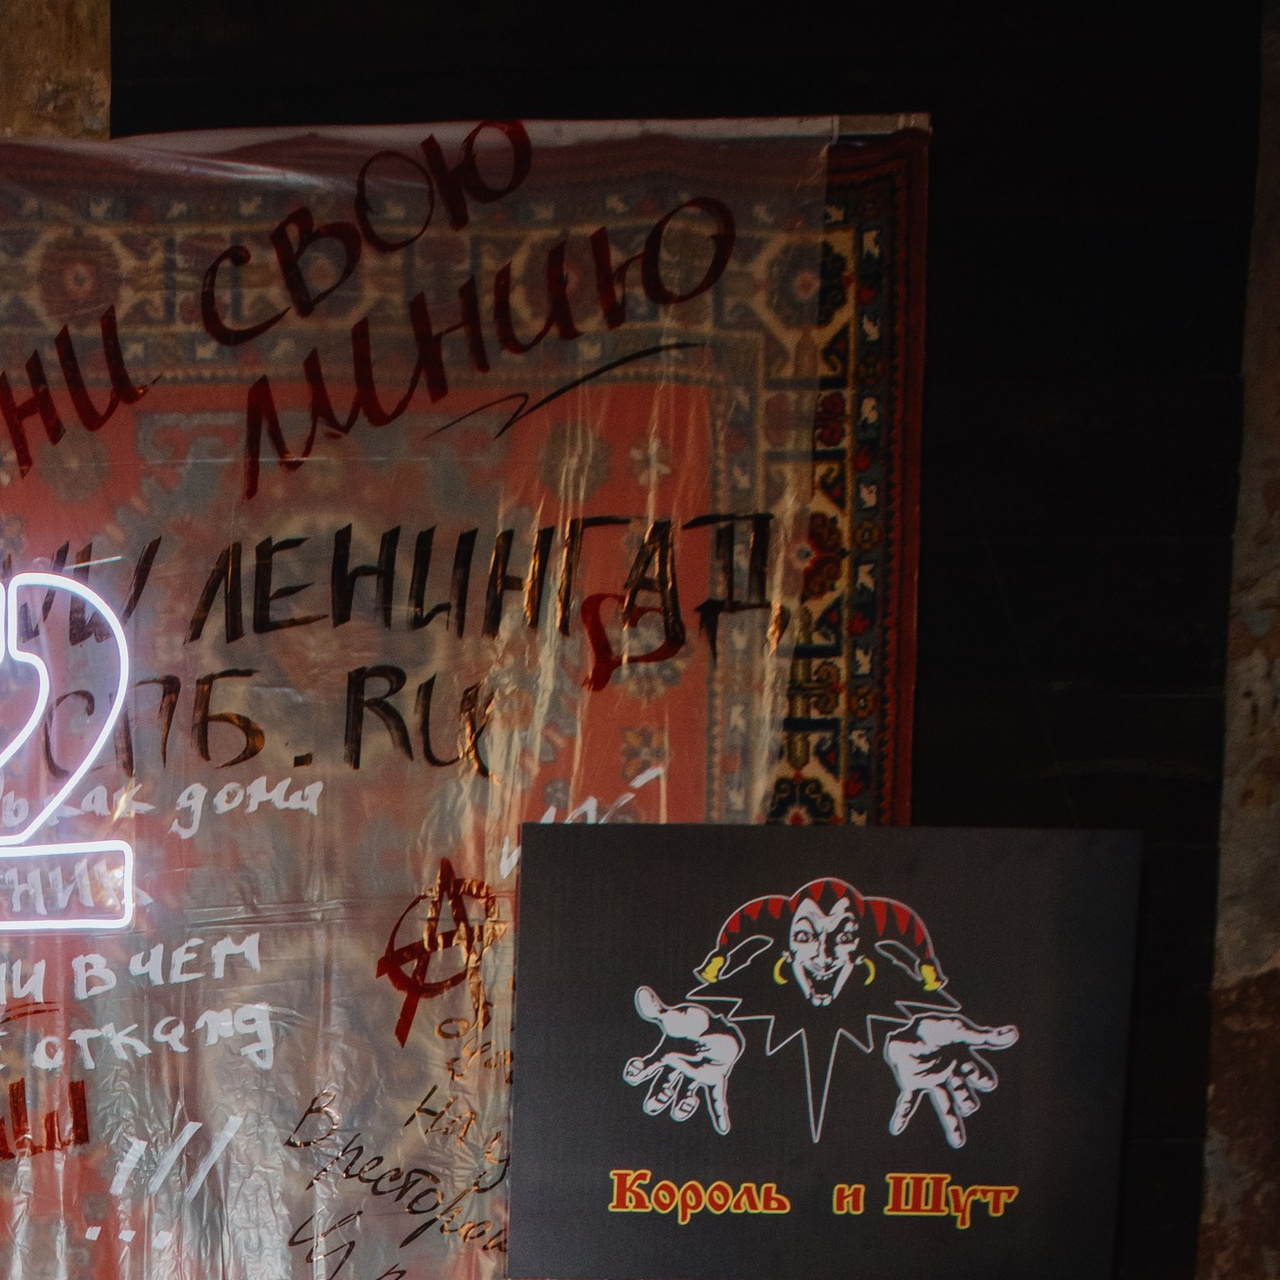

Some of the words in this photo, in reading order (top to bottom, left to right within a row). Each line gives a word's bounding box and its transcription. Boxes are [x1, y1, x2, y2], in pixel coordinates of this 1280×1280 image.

[200, 119, 532, 348] СВОЮ
[242, 196, 738, 502] ЛИНИЮ
[608, 1168, 791, 1225] Король
[832, 1182, 867, 1215] и
[883, 1171, 1019, 1229] Шут
